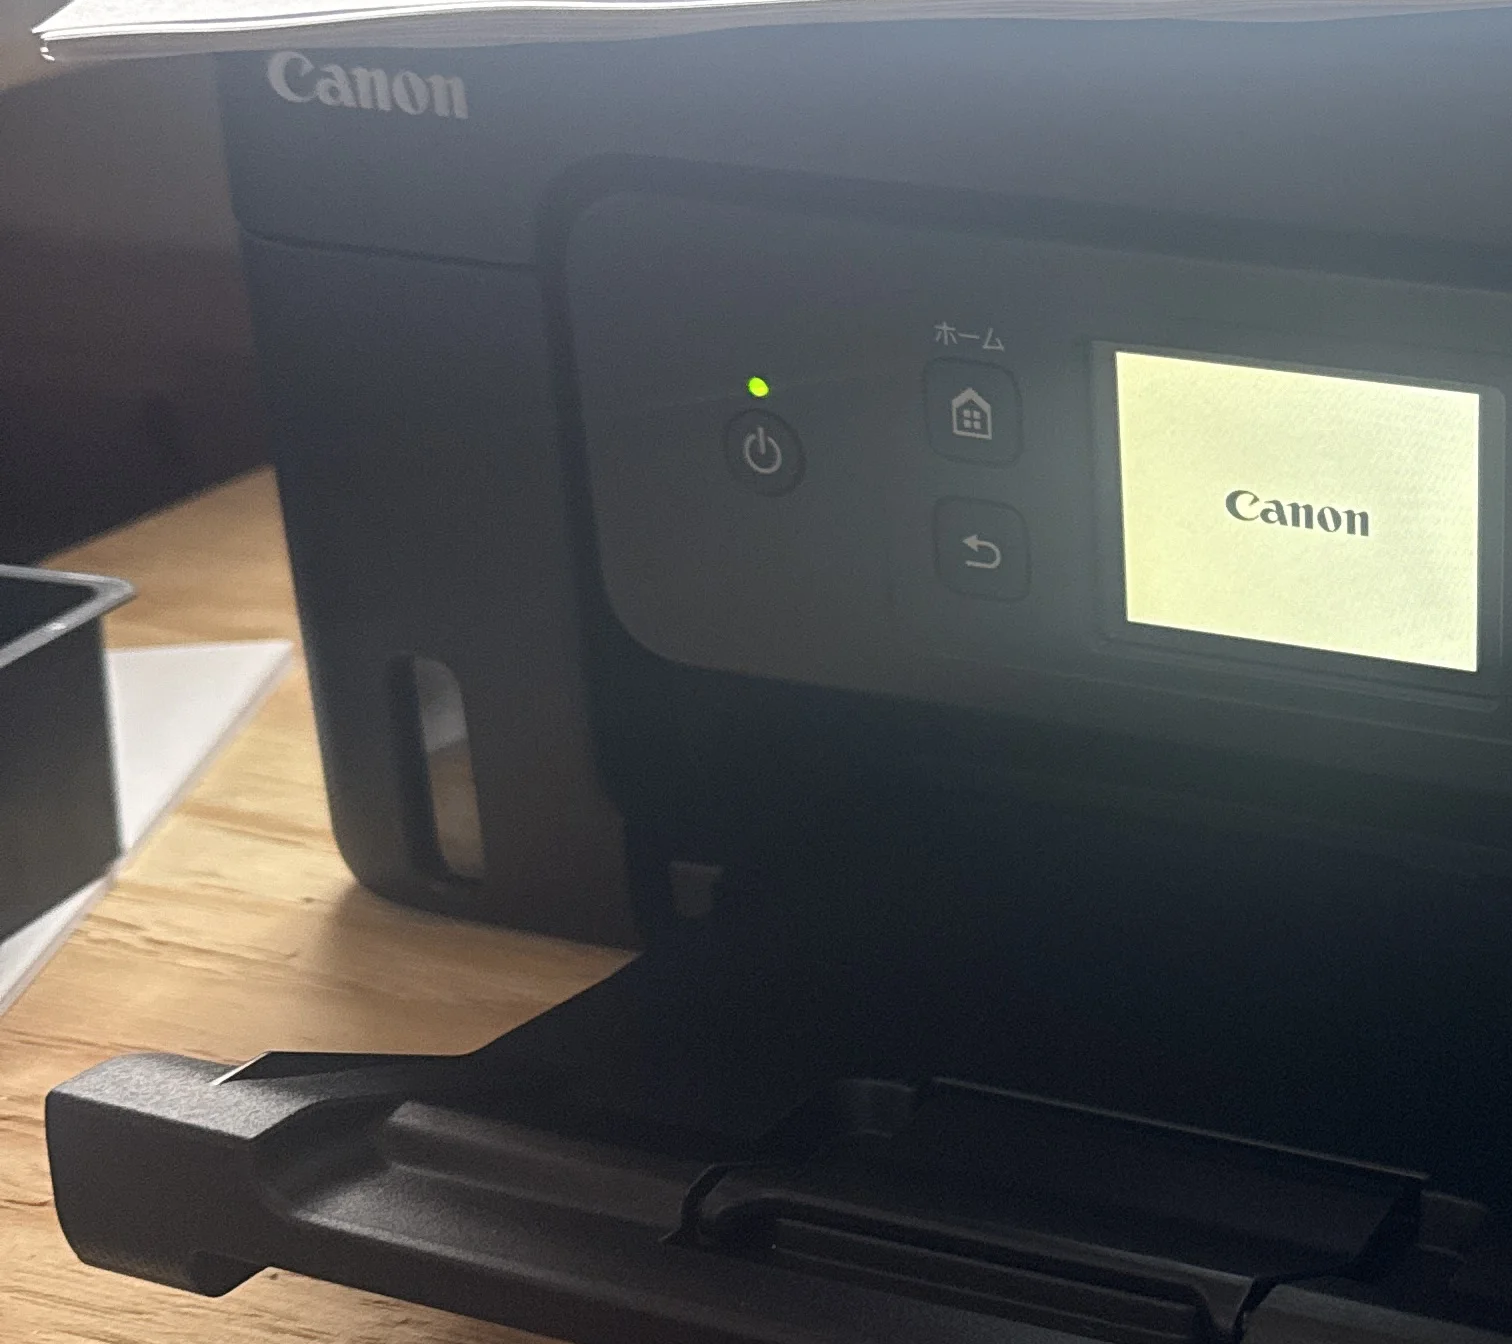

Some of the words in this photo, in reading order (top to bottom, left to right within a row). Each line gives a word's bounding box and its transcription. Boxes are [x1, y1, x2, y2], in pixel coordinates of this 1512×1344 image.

[267, 50, 469, 120] Canon
[934, 321, 1005, 352] ホーム
[1225, 489, 1370, 537] Canon
